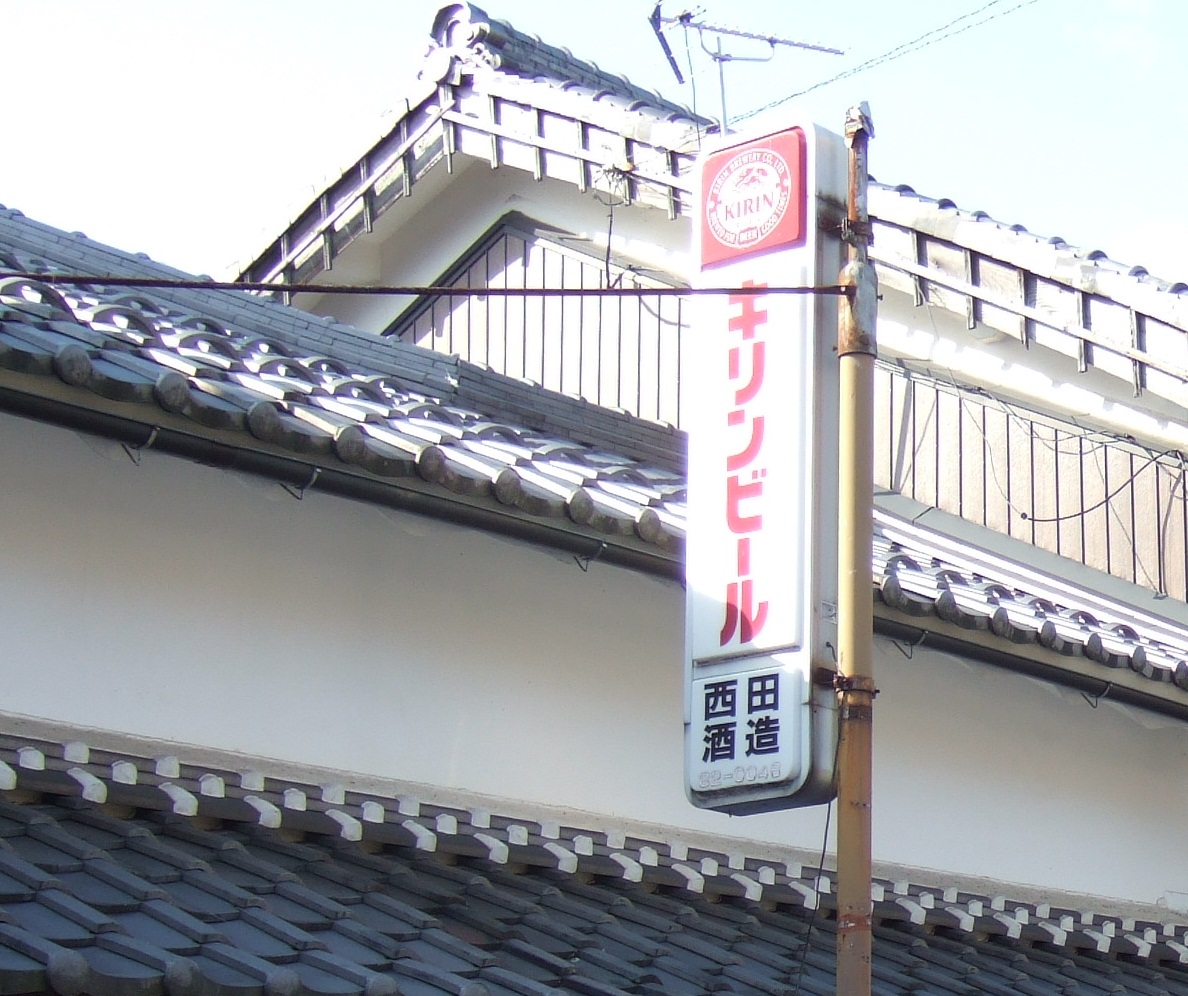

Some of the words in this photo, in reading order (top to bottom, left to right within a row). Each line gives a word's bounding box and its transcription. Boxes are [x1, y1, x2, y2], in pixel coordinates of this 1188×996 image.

[725, 192, 774, 220] KIRIN
[720, 280, 768, 647] キリンビール
[704, 673, 779, 720] 西田
[702, 716, 780, 762] 酒造
